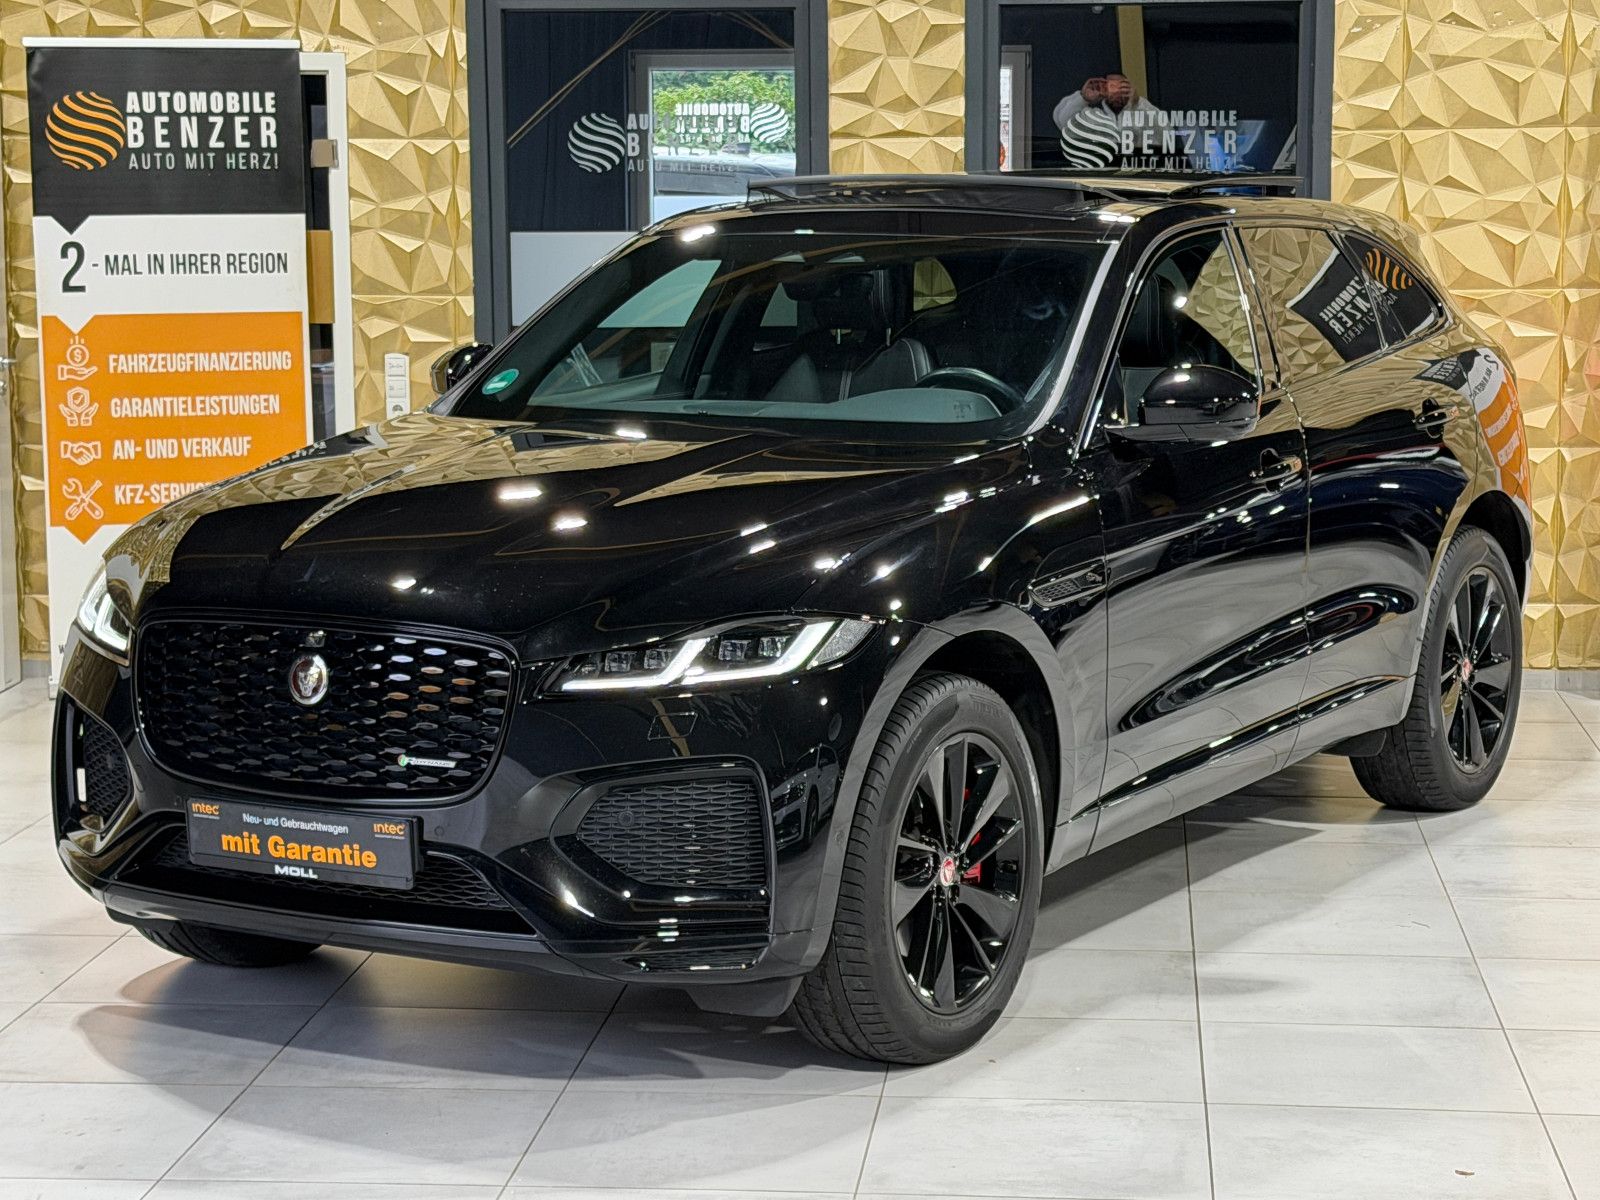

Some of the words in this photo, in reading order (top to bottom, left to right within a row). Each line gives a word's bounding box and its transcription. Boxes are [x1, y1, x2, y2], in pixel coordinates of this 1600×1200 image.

[126, 91, 276, 114] AUTOMOBILE
[1122, 110, 1238, 127] AUTOMOBILE
[127, 115, 278, 149] BENZER
[1121, 130, 1237, 155] BENZER
[128, 152, 175, 170] AUTO
[185, 152, 216, 170] MIT
[226, 152, 279, 170] HERZ!
[1164, 156, 1188, 171] MIT
[104, 254, 143, 276] MAL
[147, 253, 165, 276] IN
[169, 253, 221, 275] IHRER
[226, 252, 289, 274] REGION
[108, 351, 292, 374] FAHRZEUGFINANZIERUNG
[111, 394, 280, 418] GARANTIELEISTUNGEN
[112, 439, 142, 460] AN-
[145, 438, 178, 459] UND
[181, 436, 252, 458] VERKAUF
[192, 802, 220, 816] intec
[242, 813, 262, 826] Neu-
[263, 816, 279, 827] und
[280, 817, 349, 836] Gebrauchtwagen
[373, 823, 406, 836] intec
[221, 831, 261, 855] mit
[268, 834, 377, 868] Garantie
[274, 864, 318, 879] MOLL
